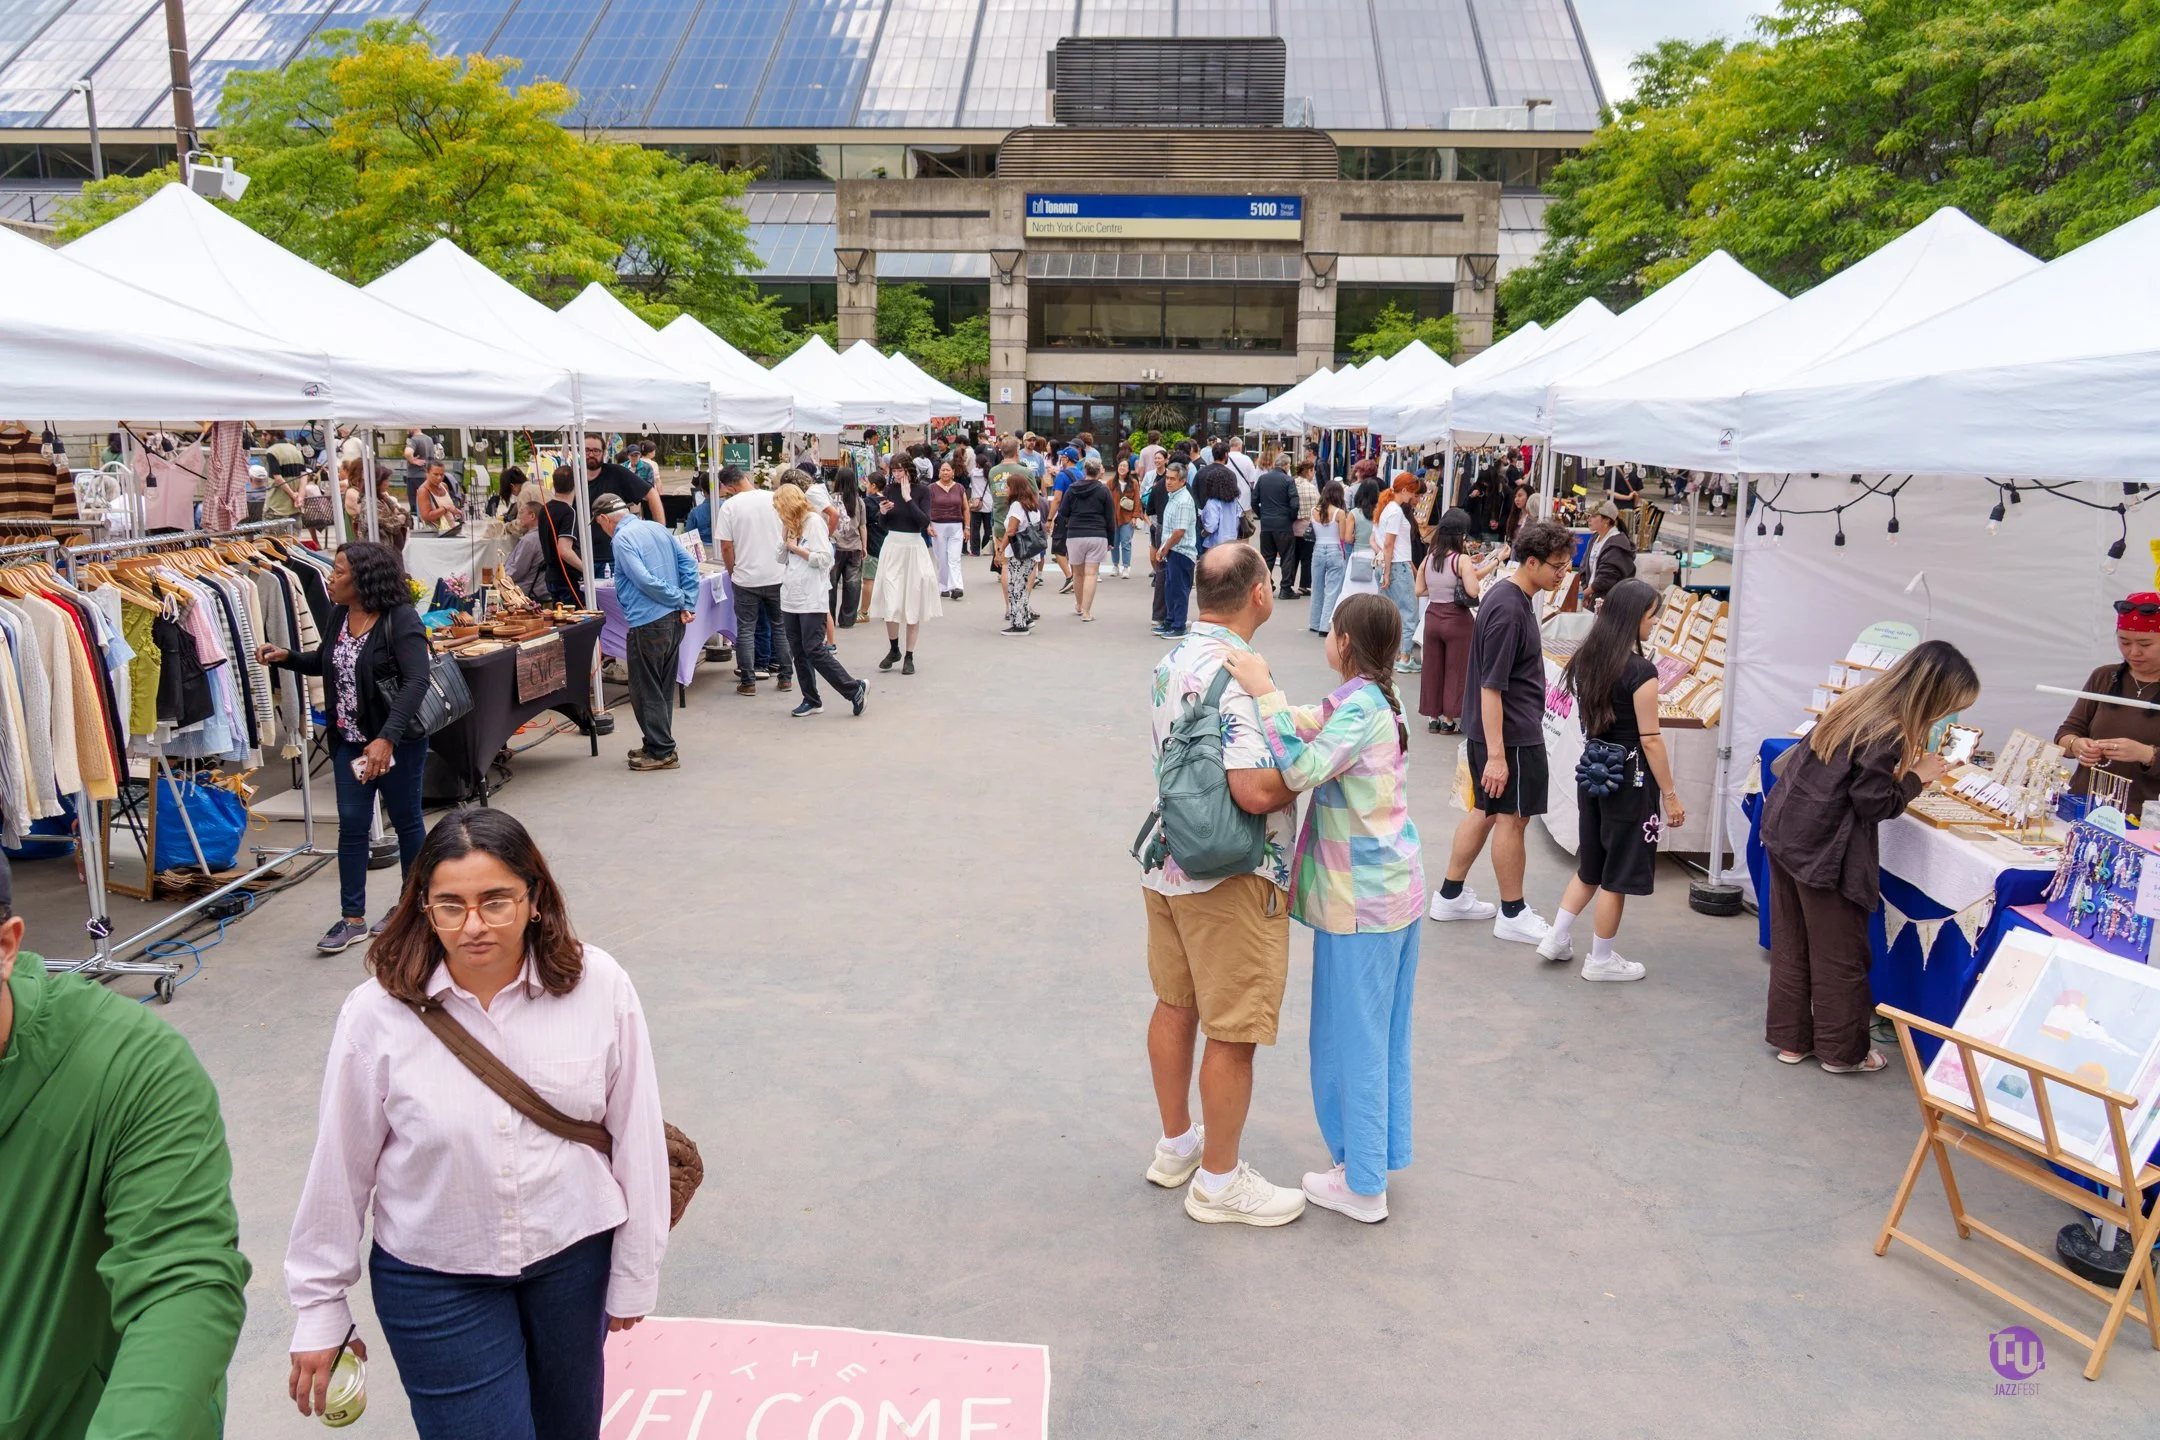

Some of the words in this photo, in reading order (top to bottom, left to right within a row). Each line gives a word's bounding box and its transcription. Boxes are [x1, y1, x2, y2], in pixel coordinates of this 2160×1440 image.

[1044, 200, 1079, 214] TORONTO
[1250, 202, 1277, 216] 5100
[1032, 222, 1055, 232] North
[1056, 222, 1074, 233] York
[1075, 222, 1095, 233] Civic
[1096, 222, 1123, 233] Centre
[730, 1349, 868, 1383] THE
